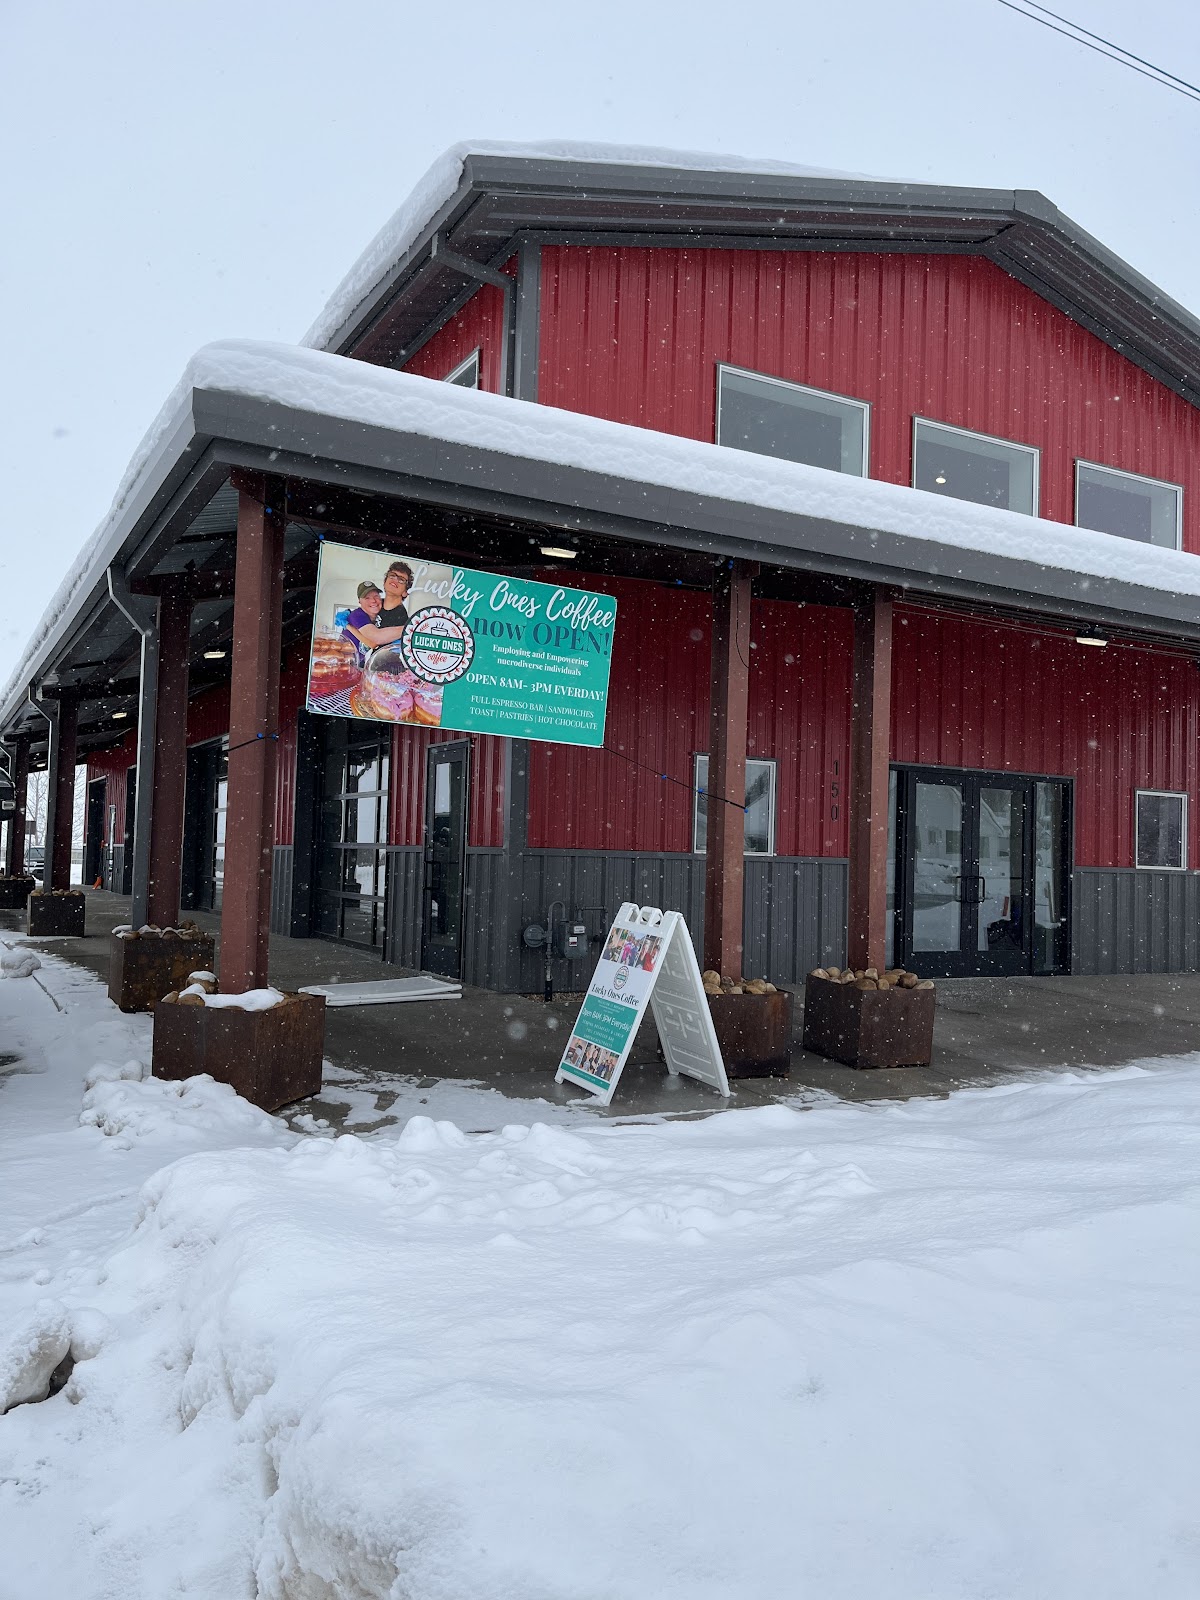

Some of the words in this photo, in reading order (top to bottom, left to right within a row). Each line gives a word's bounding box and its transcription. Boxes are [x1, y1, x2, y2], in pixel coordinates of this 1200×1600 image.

[408, 565, 484, 618] Lucky
[489, 580, 541, 618] Ones
[546, 589, 615, 631] Coffee
[414, 636, 440, 649] LUCKY
[442, 641, 463, 652] ONES
[473, 617, 526, 641] now
[533, 622, 610, 656] OPEN!
[427, 652, 448, 665] coffee
[493, 644, 530, 659] Employing
[532, 651, 545, 660] and
[546, 652, 589, 667] Empowering
[544, 663, 582, 677] individuals
[466, 672, 498, 686] OPEN
[531, 681, 552, 694] 3PM
[554, 685, 604, 701] EVERDAY!
[471, 694, 491, 705] FULL
[491, 697, 529, 709] ESPRESSO
[529, 703, 544, 712] BAR
[548, 704, 595, 718] SANDWICHES
[470, 706, 495, 717] TOAST
[500, 710, 533, 722] PASTRIES
[538, 715, 554, 724] HOT
[554, 717, 598, 730] CHOCOLATE
[592, 983, 607, 998] Lucky
[607, 988, 621, 1001] Ones
[620, 992, 640, 1006] Coffee
